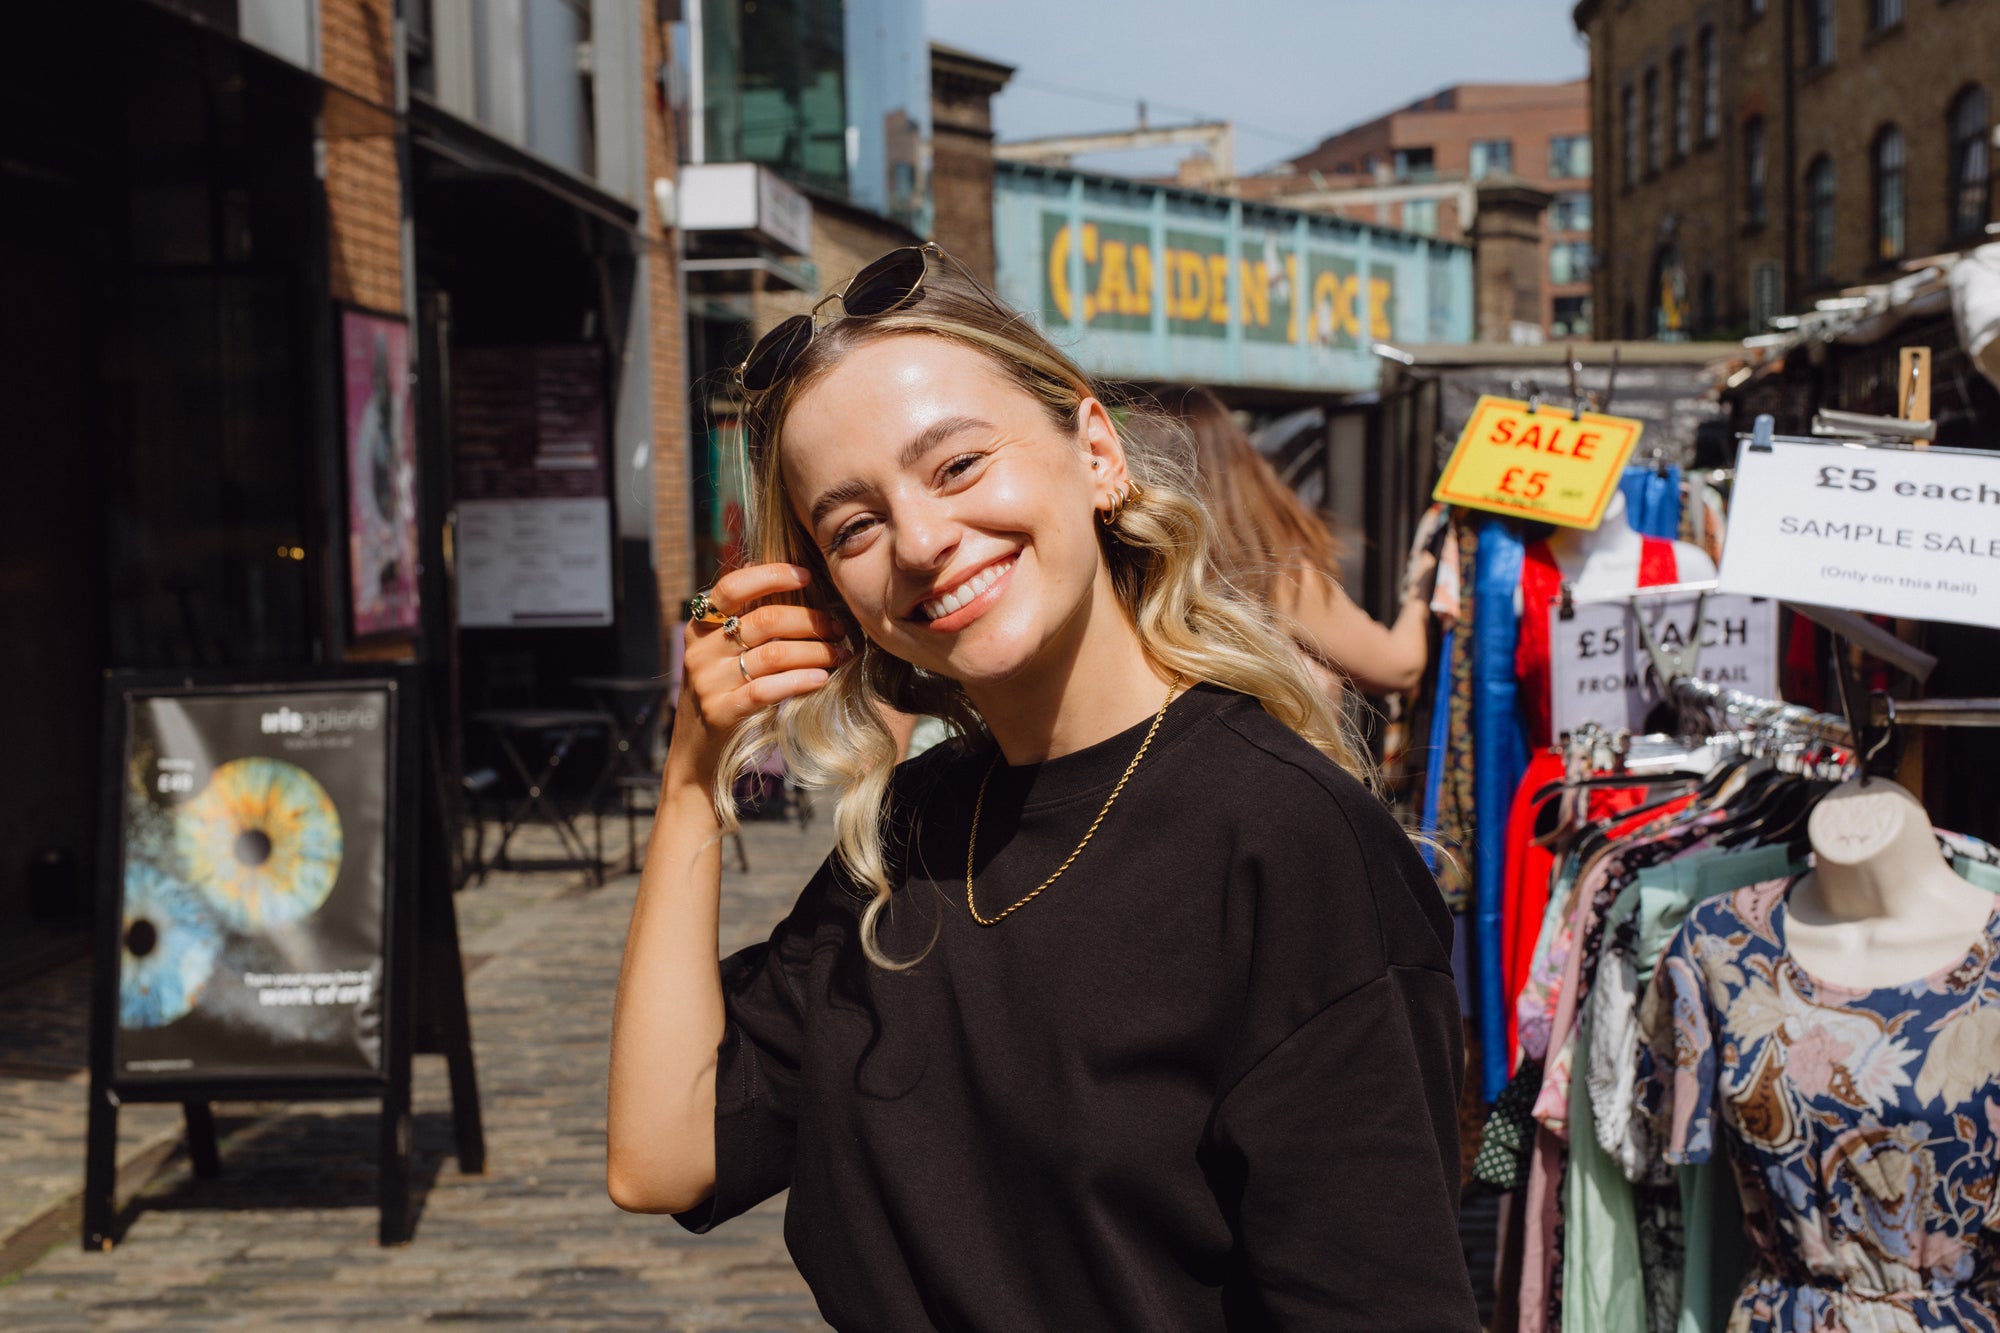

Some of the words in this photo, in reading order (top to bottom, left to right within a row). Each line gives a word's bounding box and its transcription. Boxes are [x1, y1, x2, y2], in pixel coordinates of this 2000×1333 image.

[1049, 223, 1270, 328] CAMDEN
[1490, 419, 1602, 460] SALE
[1498, 466, 1549, 499] £5
[1816, 465, 1878, 493] £5
[1894, 480, 2000, 505] each
[1780, 515, 1914, 549] SAMPLE
[1923, 530, 2000, 559] SALE
[1820, 565, 1868, 583] (Only
[1872, 573, 1894, 585] on
[1899, 576, 1932, 590] this
[1937, 579, 1979, 596] Rail)
[1578, 626, 1621, 658] £5
[1577, 671, 1639, 695] FROM
